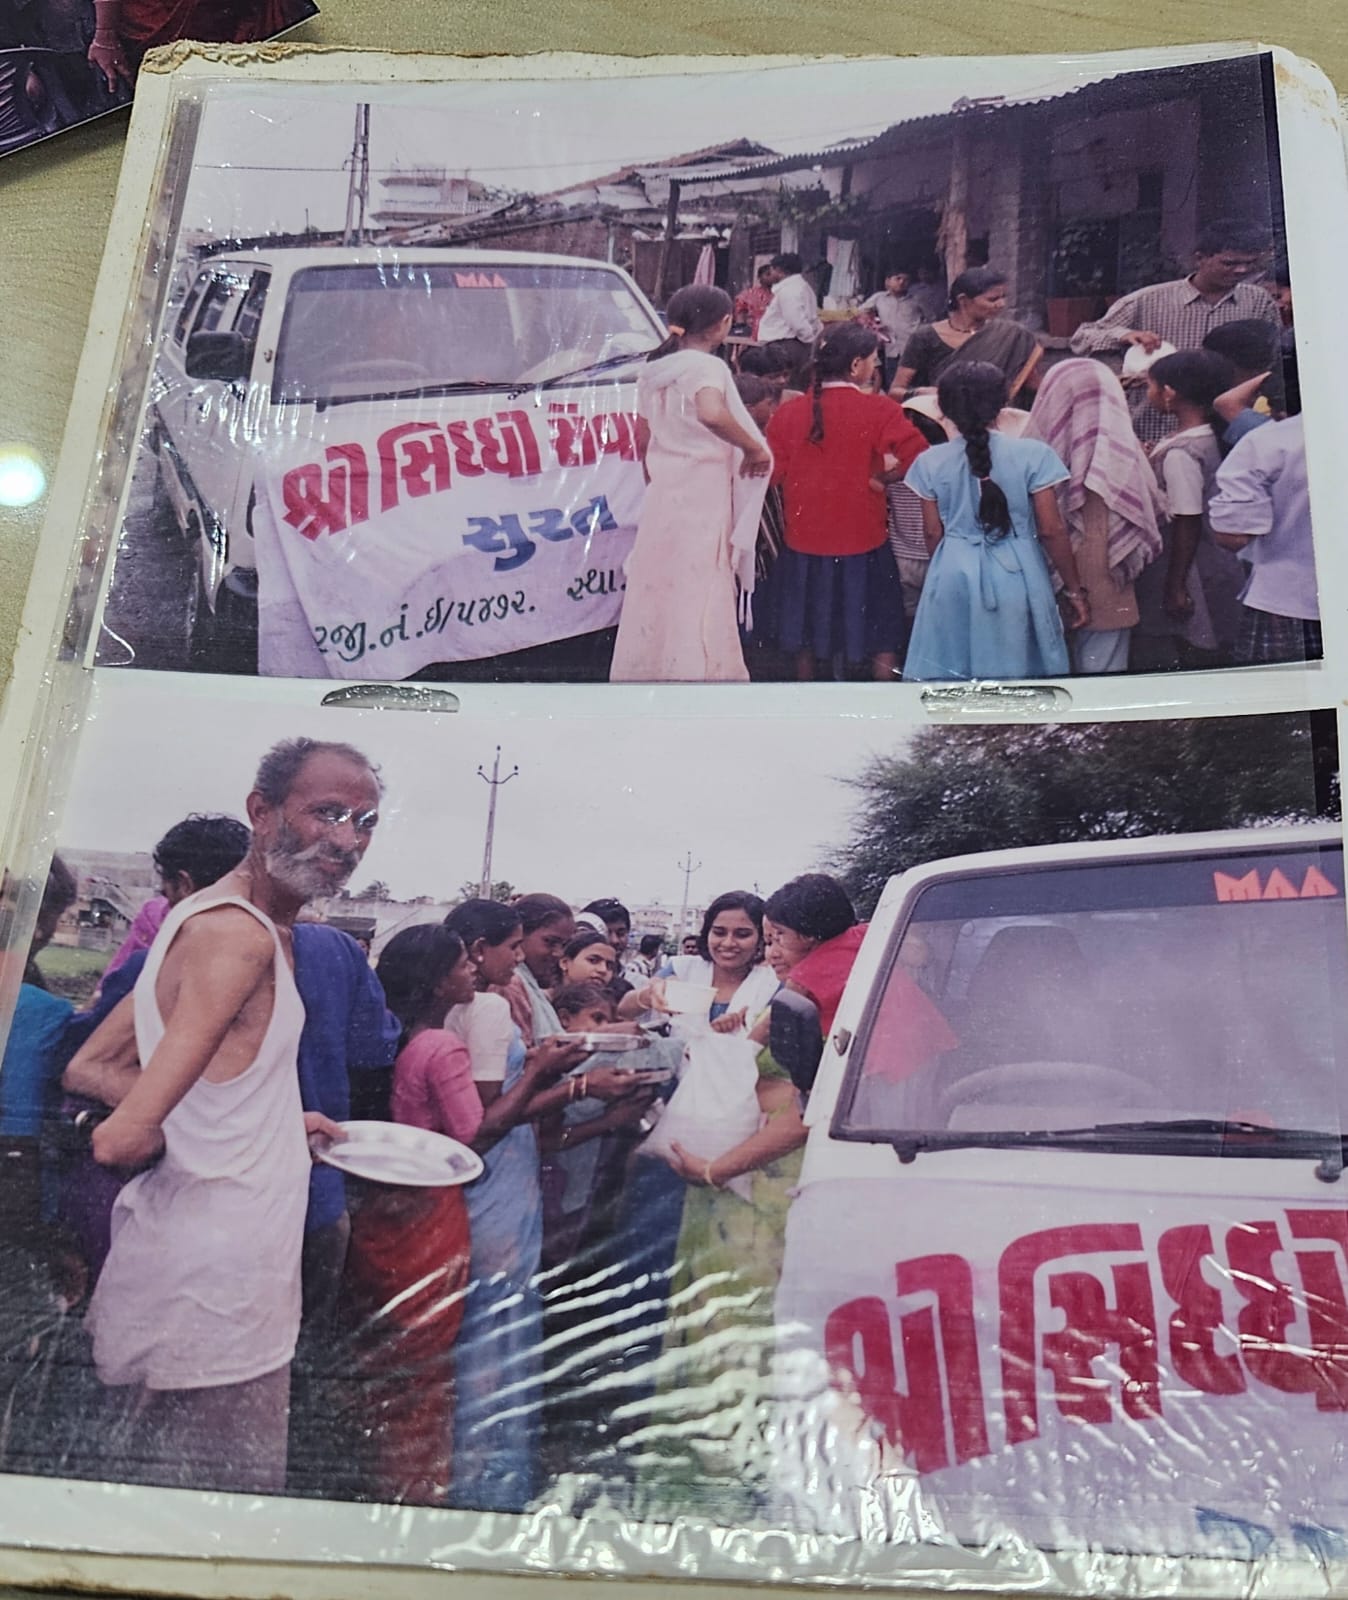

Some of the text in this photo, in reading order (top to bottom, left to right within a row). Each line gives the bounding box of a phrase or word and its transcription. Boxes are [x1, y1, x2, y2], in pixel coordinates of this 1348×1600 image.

[455, 272, 507, 288] MAA
[282, 442, 370, 542] શ્રી
[462, 494, 618, 572] સુરત
[1213, 863, 1338, 903] MAA
